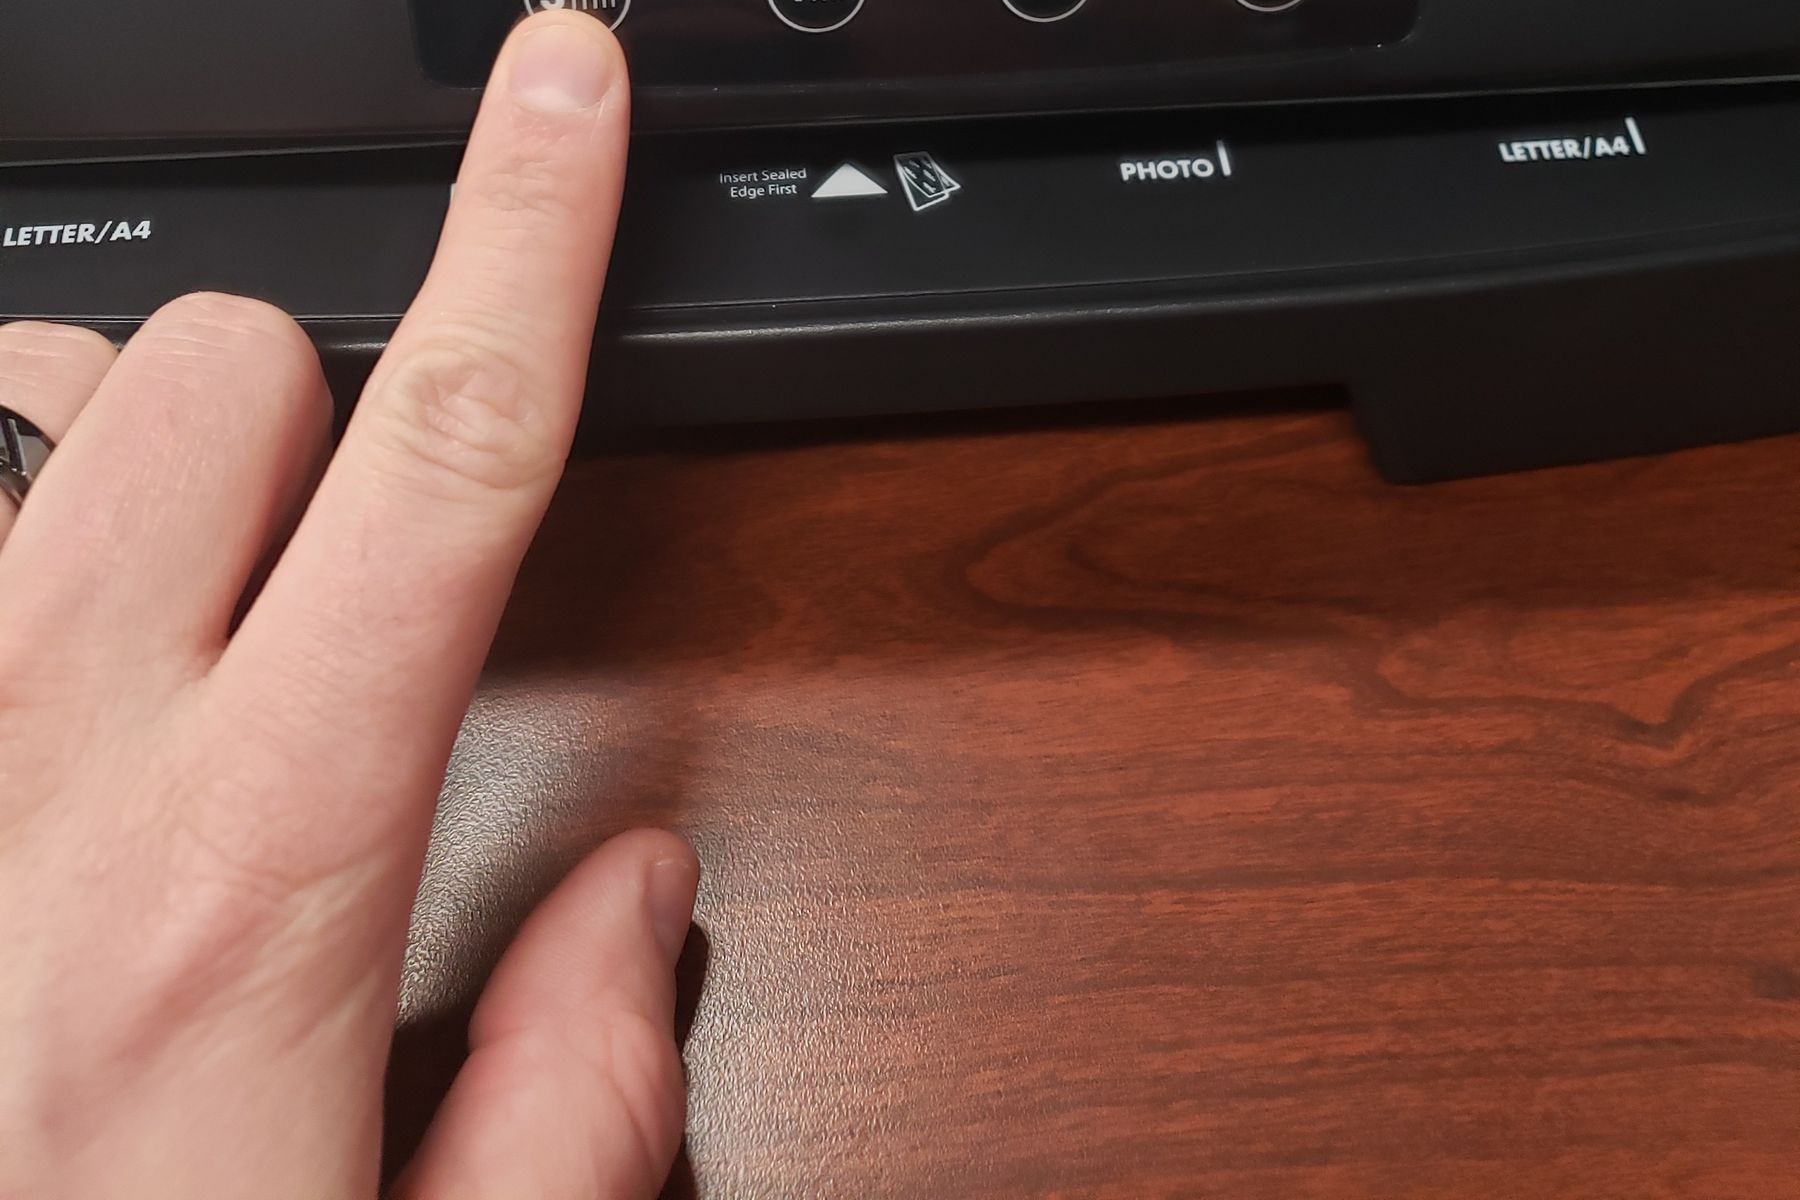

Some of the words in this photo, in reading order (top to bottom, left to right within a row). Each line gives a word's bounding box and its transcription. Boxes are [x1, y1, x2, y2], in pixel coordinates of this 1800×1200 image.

[1498, 136, 1630, 163] LETTER/A4
[719, 171, 759, 184] Insert
[762, 168, 807, 182] Sealed
[1119, 158, 1215, 181] PHOTO
[730, 185, 766, 200] Edge
[768, 183, 798, 196] First
[2, 220, 152, 247] LETTER/A4
